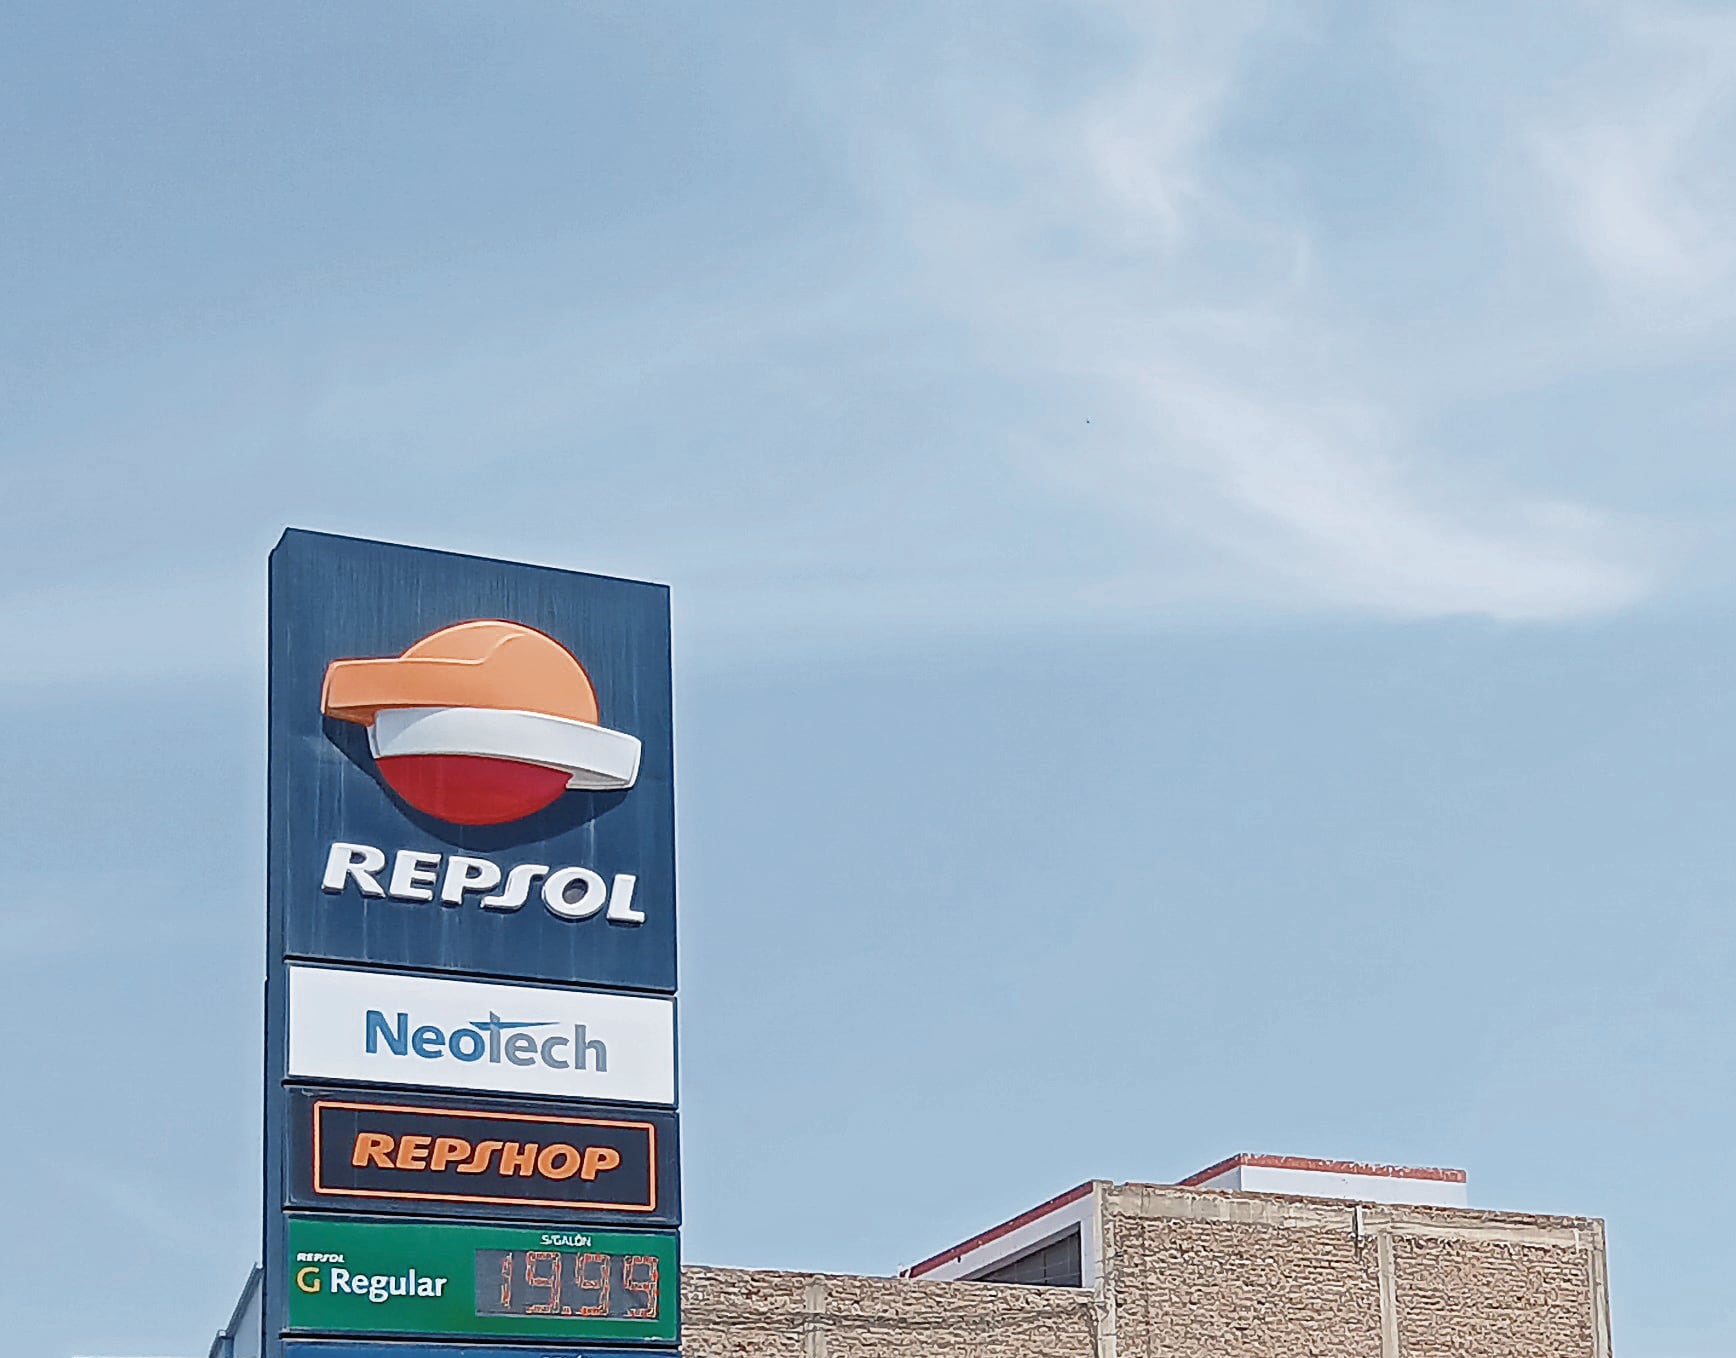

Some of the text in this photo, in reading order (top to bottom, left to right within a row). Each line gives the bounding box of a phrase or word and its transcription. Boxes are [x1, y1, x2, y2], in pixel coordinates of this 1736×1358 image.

[322, 842, 646, 926] REPSOL
[351, 1132, 621, 1182] REPSHOP
[296, 1252, 345, 1264] REPSOL
[296, 1266, 448, 1304] G Regular
